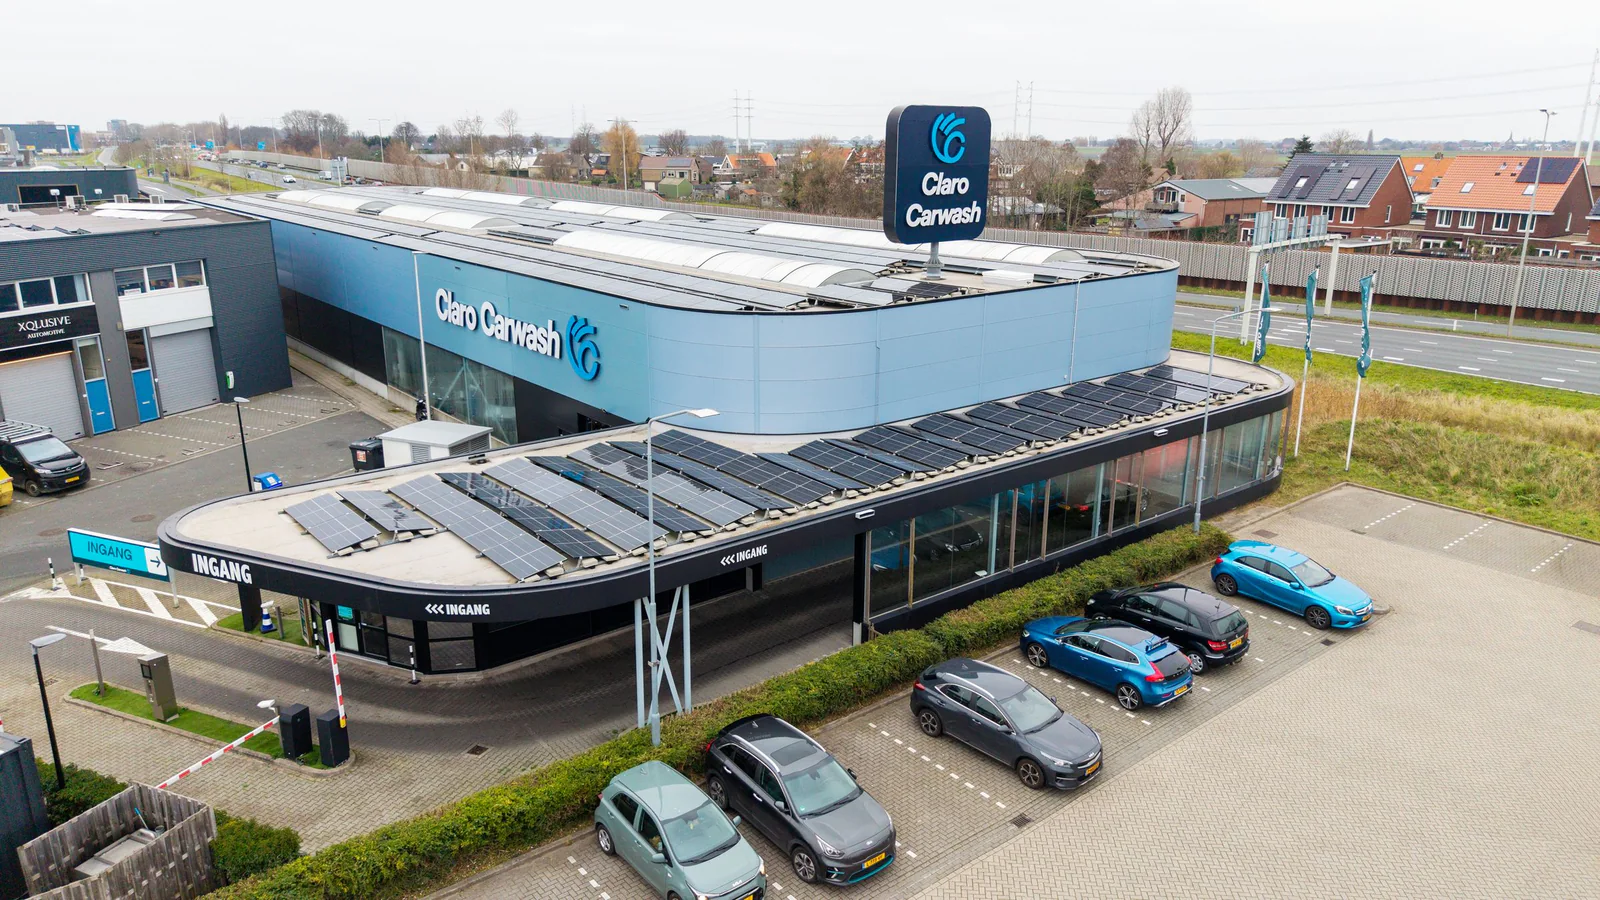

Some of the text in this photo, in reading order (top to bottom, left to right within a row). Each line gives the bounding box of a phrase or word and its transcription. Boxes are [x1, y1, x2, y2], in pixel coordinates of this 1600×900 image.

[922, 172, 970, 196] Claro
[906, 201, 982, 228] Carwash
[18, 315, 72, 332] XQLUSIVE
[27, 328, 65, 339] AUTOMOTIVE
[435, 288, 562, 359] Claro Carwash
[87, 541, 133, 561] INGANG
[736, 544, 768, 563] INGANG
[192, 553, 252, 585] INGANG
[446, 603, 491, 616] INGANG
